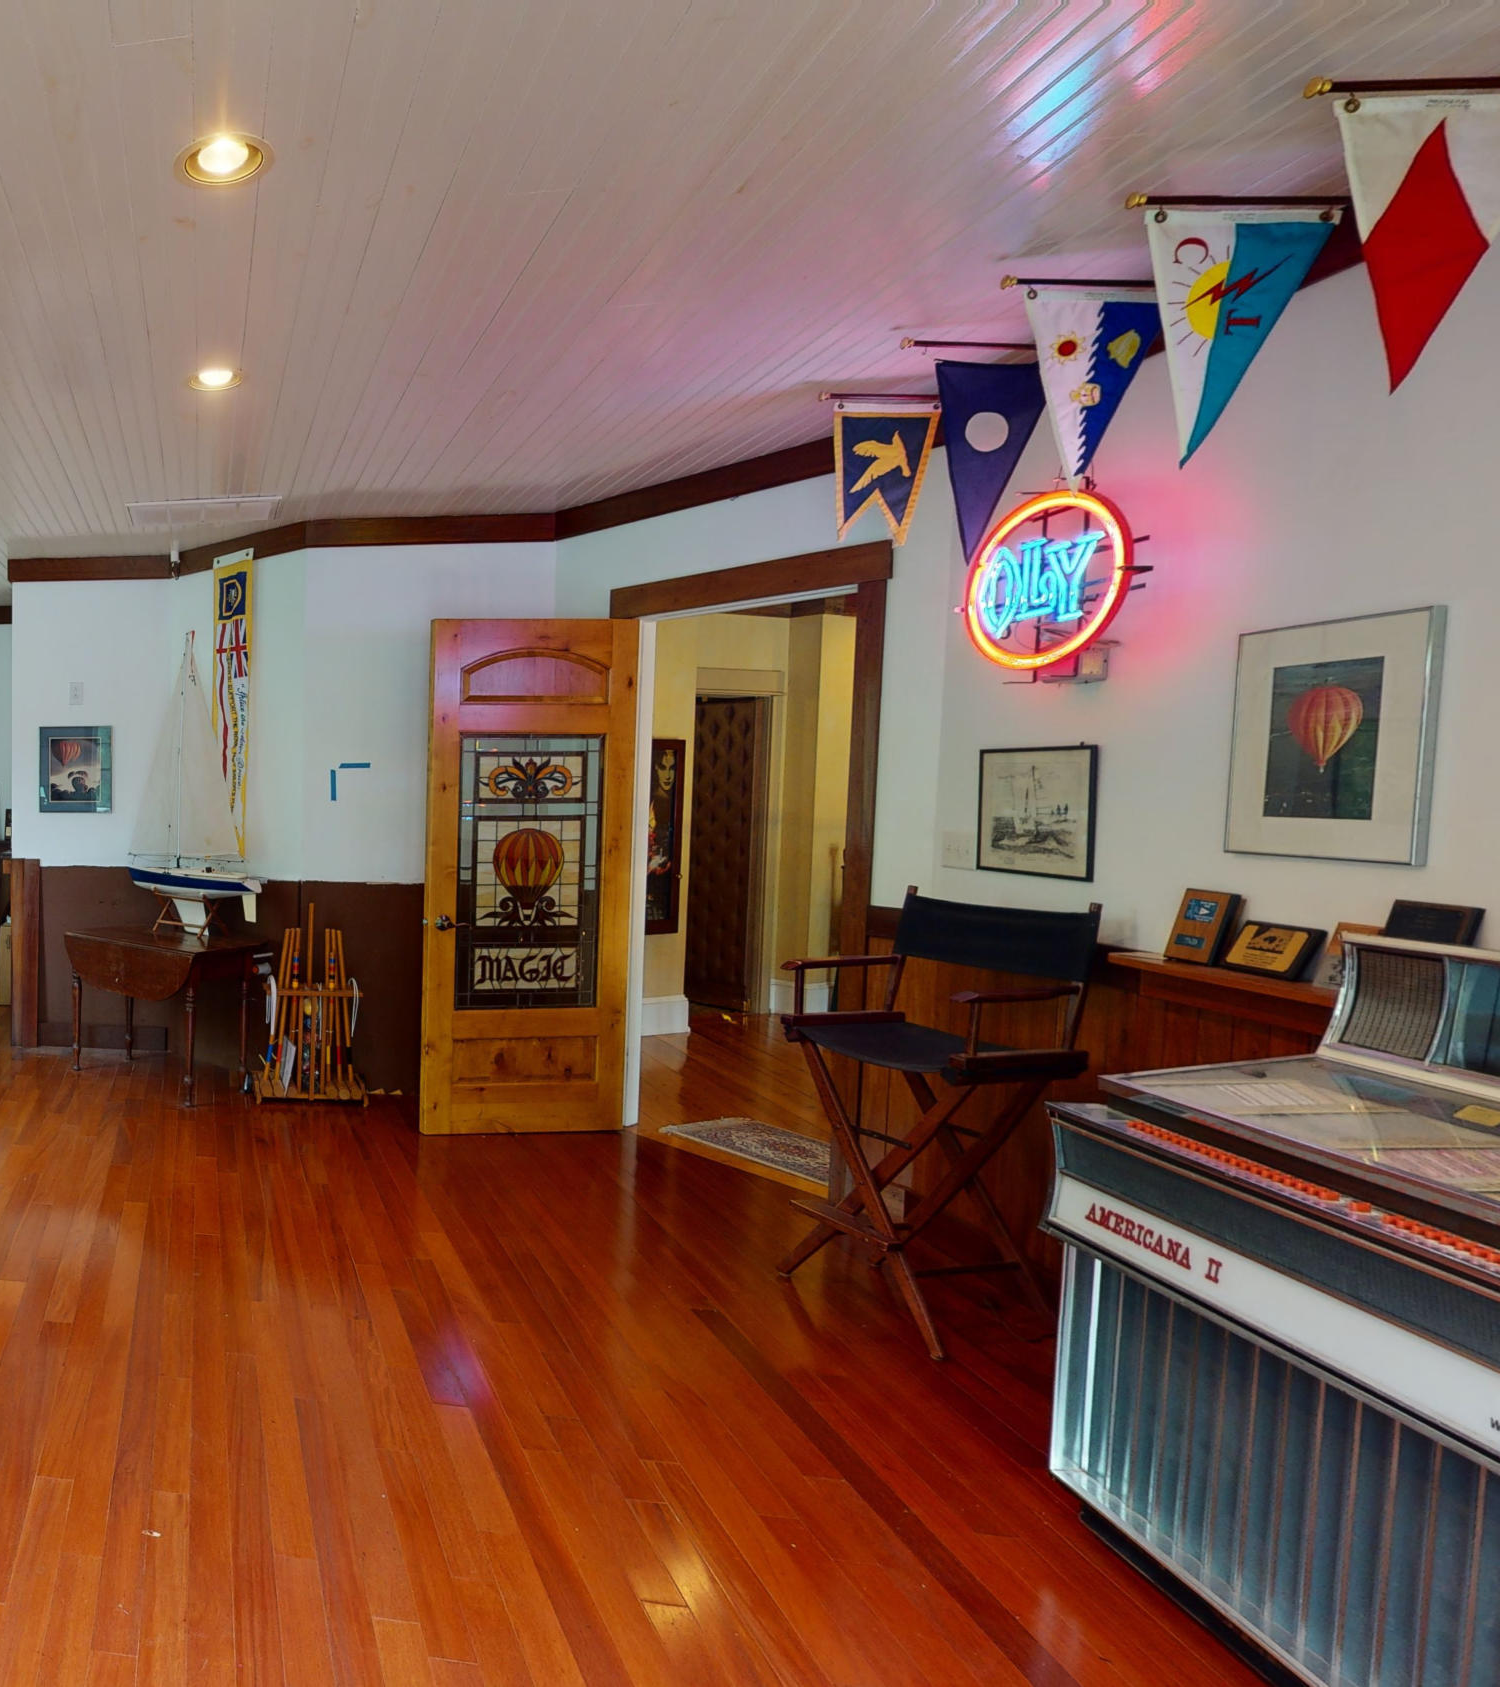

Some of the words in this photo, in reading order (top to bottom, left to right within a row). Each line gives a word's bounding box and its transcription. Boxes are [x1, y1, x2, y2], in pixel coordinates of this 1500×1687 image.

[980, 530, 1107, 640] OLY
[475, 953, 577, 985] MAGIC
[1085, 1202, 1192, 1271] AMERICANA
[1204, 1257, 1223, 1284] II
